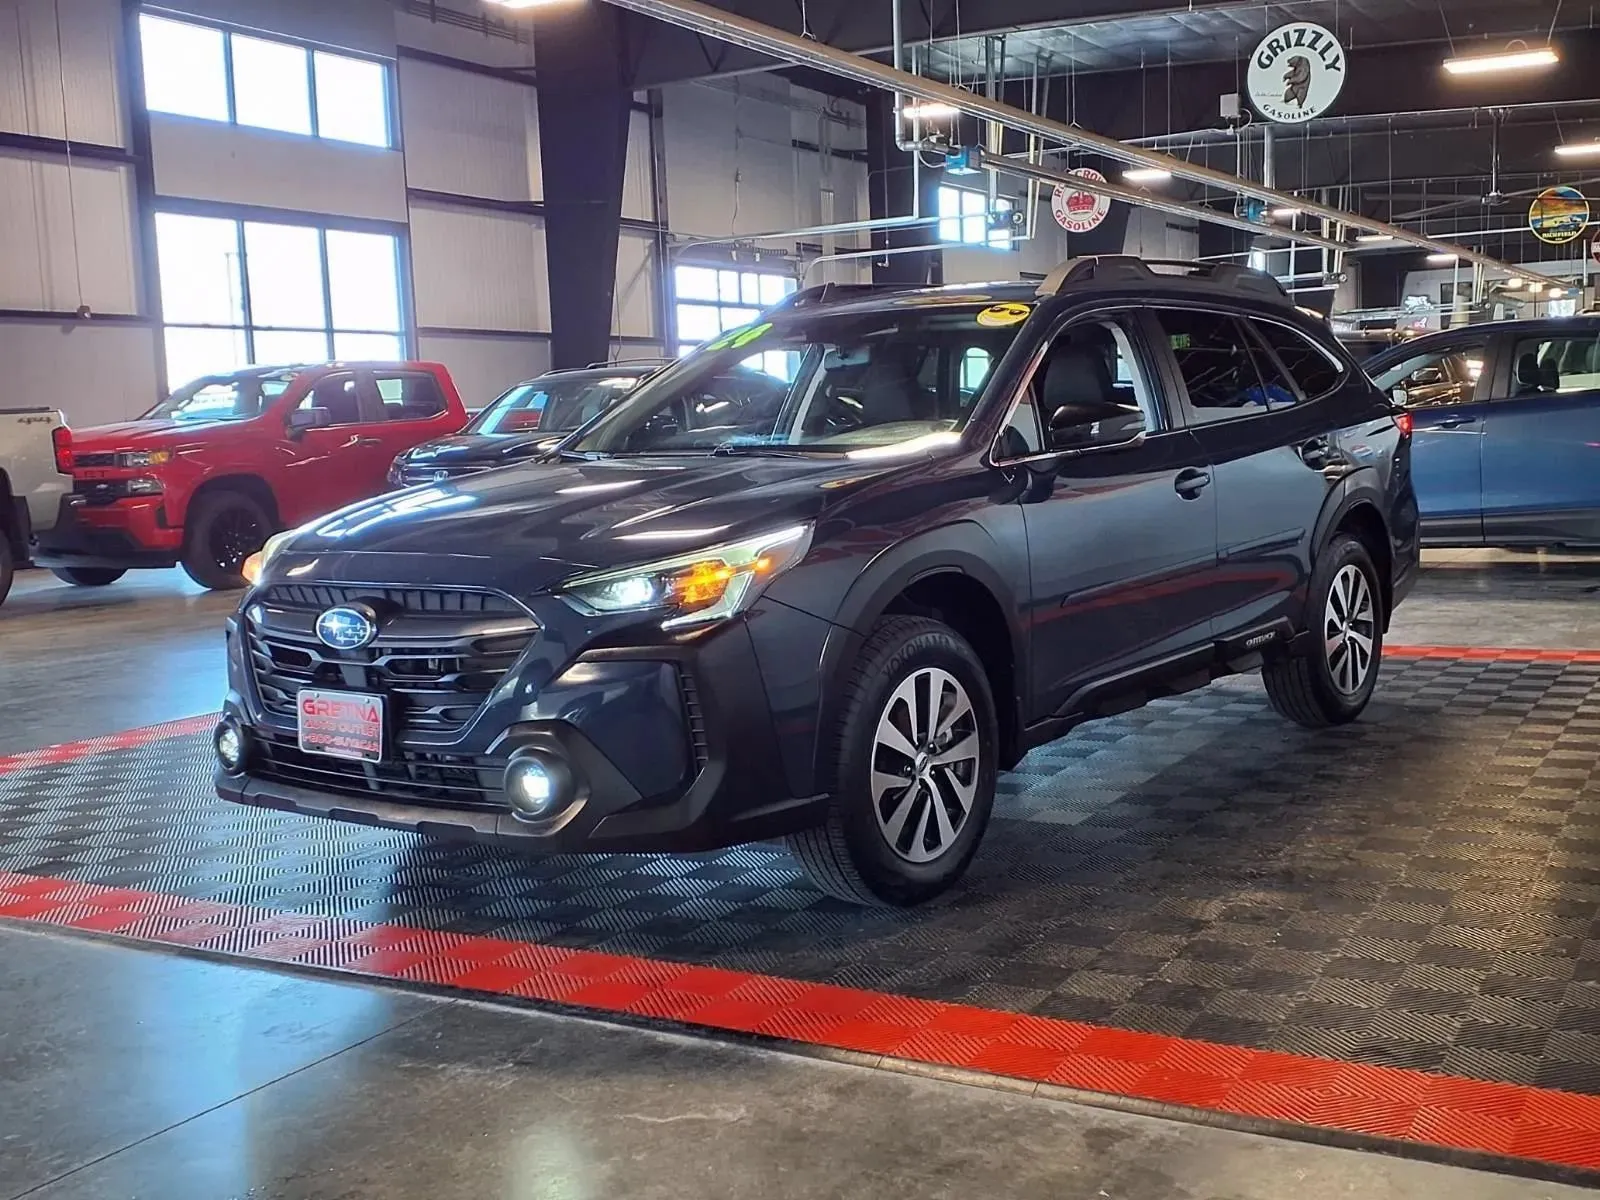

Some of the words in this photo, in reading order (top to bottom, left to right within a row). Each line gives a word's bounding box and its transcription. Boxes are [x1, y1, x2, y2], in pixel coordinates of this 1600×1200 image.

[1257, 28, 1341, 72] GRIZZLY
[1263, 104, 1317, 120] GASOLINE
[1055, 208, 1106, 231] GASOLINE
[303, 699, 379, 723] GRETNA
[304, 719, 336, 732] AUTO
[338, 722, 379, 738] OUTLET
